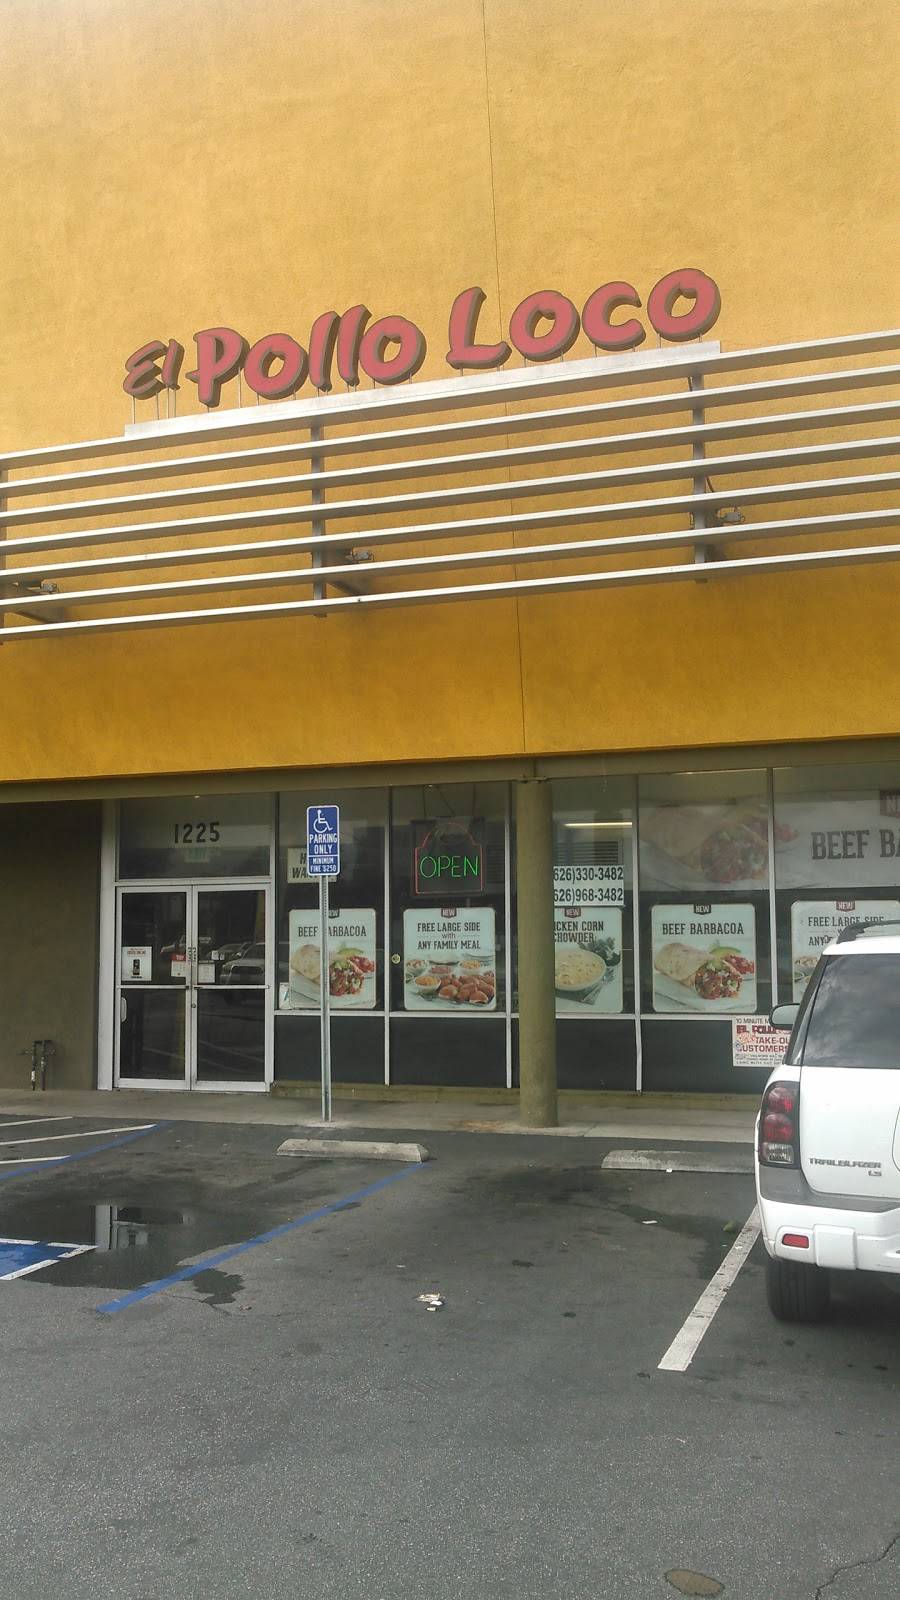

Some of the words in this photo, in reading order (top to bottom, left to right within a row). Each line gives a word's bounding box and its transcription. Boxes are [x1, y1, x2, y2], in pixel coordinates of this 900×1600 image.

[124, 338, 184, 398] El
[186, 304, 427, 407] Pollo
[174, 821, 220, 844] 1225
[309, 833, 338, 844] PARKING
[314, 844, 333, 854] ONLY
[811, 830, 870, 859] BEEF
[312, 857, 334, 865] MINIMUM
[420, 855, 479, 878] OPEN
[310, 865, 322, 873] FINE
[554, 866, 624, 884] 626)330-3482
[554, 887, 623, 906] 626)968-3482
[695, 904, 710, 913] NEW
[838, 901, 853, 910] NEW
[417, 922, 435, 932] FREE
[437, 922, 461, 932] LARGE
[464, 921, 481, 931] SIDE
[581, 920, 604, 931] CORN
[808, 916, 831, 927] FREE
[298, 926, 318, 937] BEEF
[328, 925, 367, 937] ARBACOA
[662, 923, 686, 934] BEEF
[690, 922, 744, 934] BARBACOA
[417, 941, 432, 950] ANY
[433, 941, 459, 950] FAMILY
[460, 940, 481, 949] MEAL
